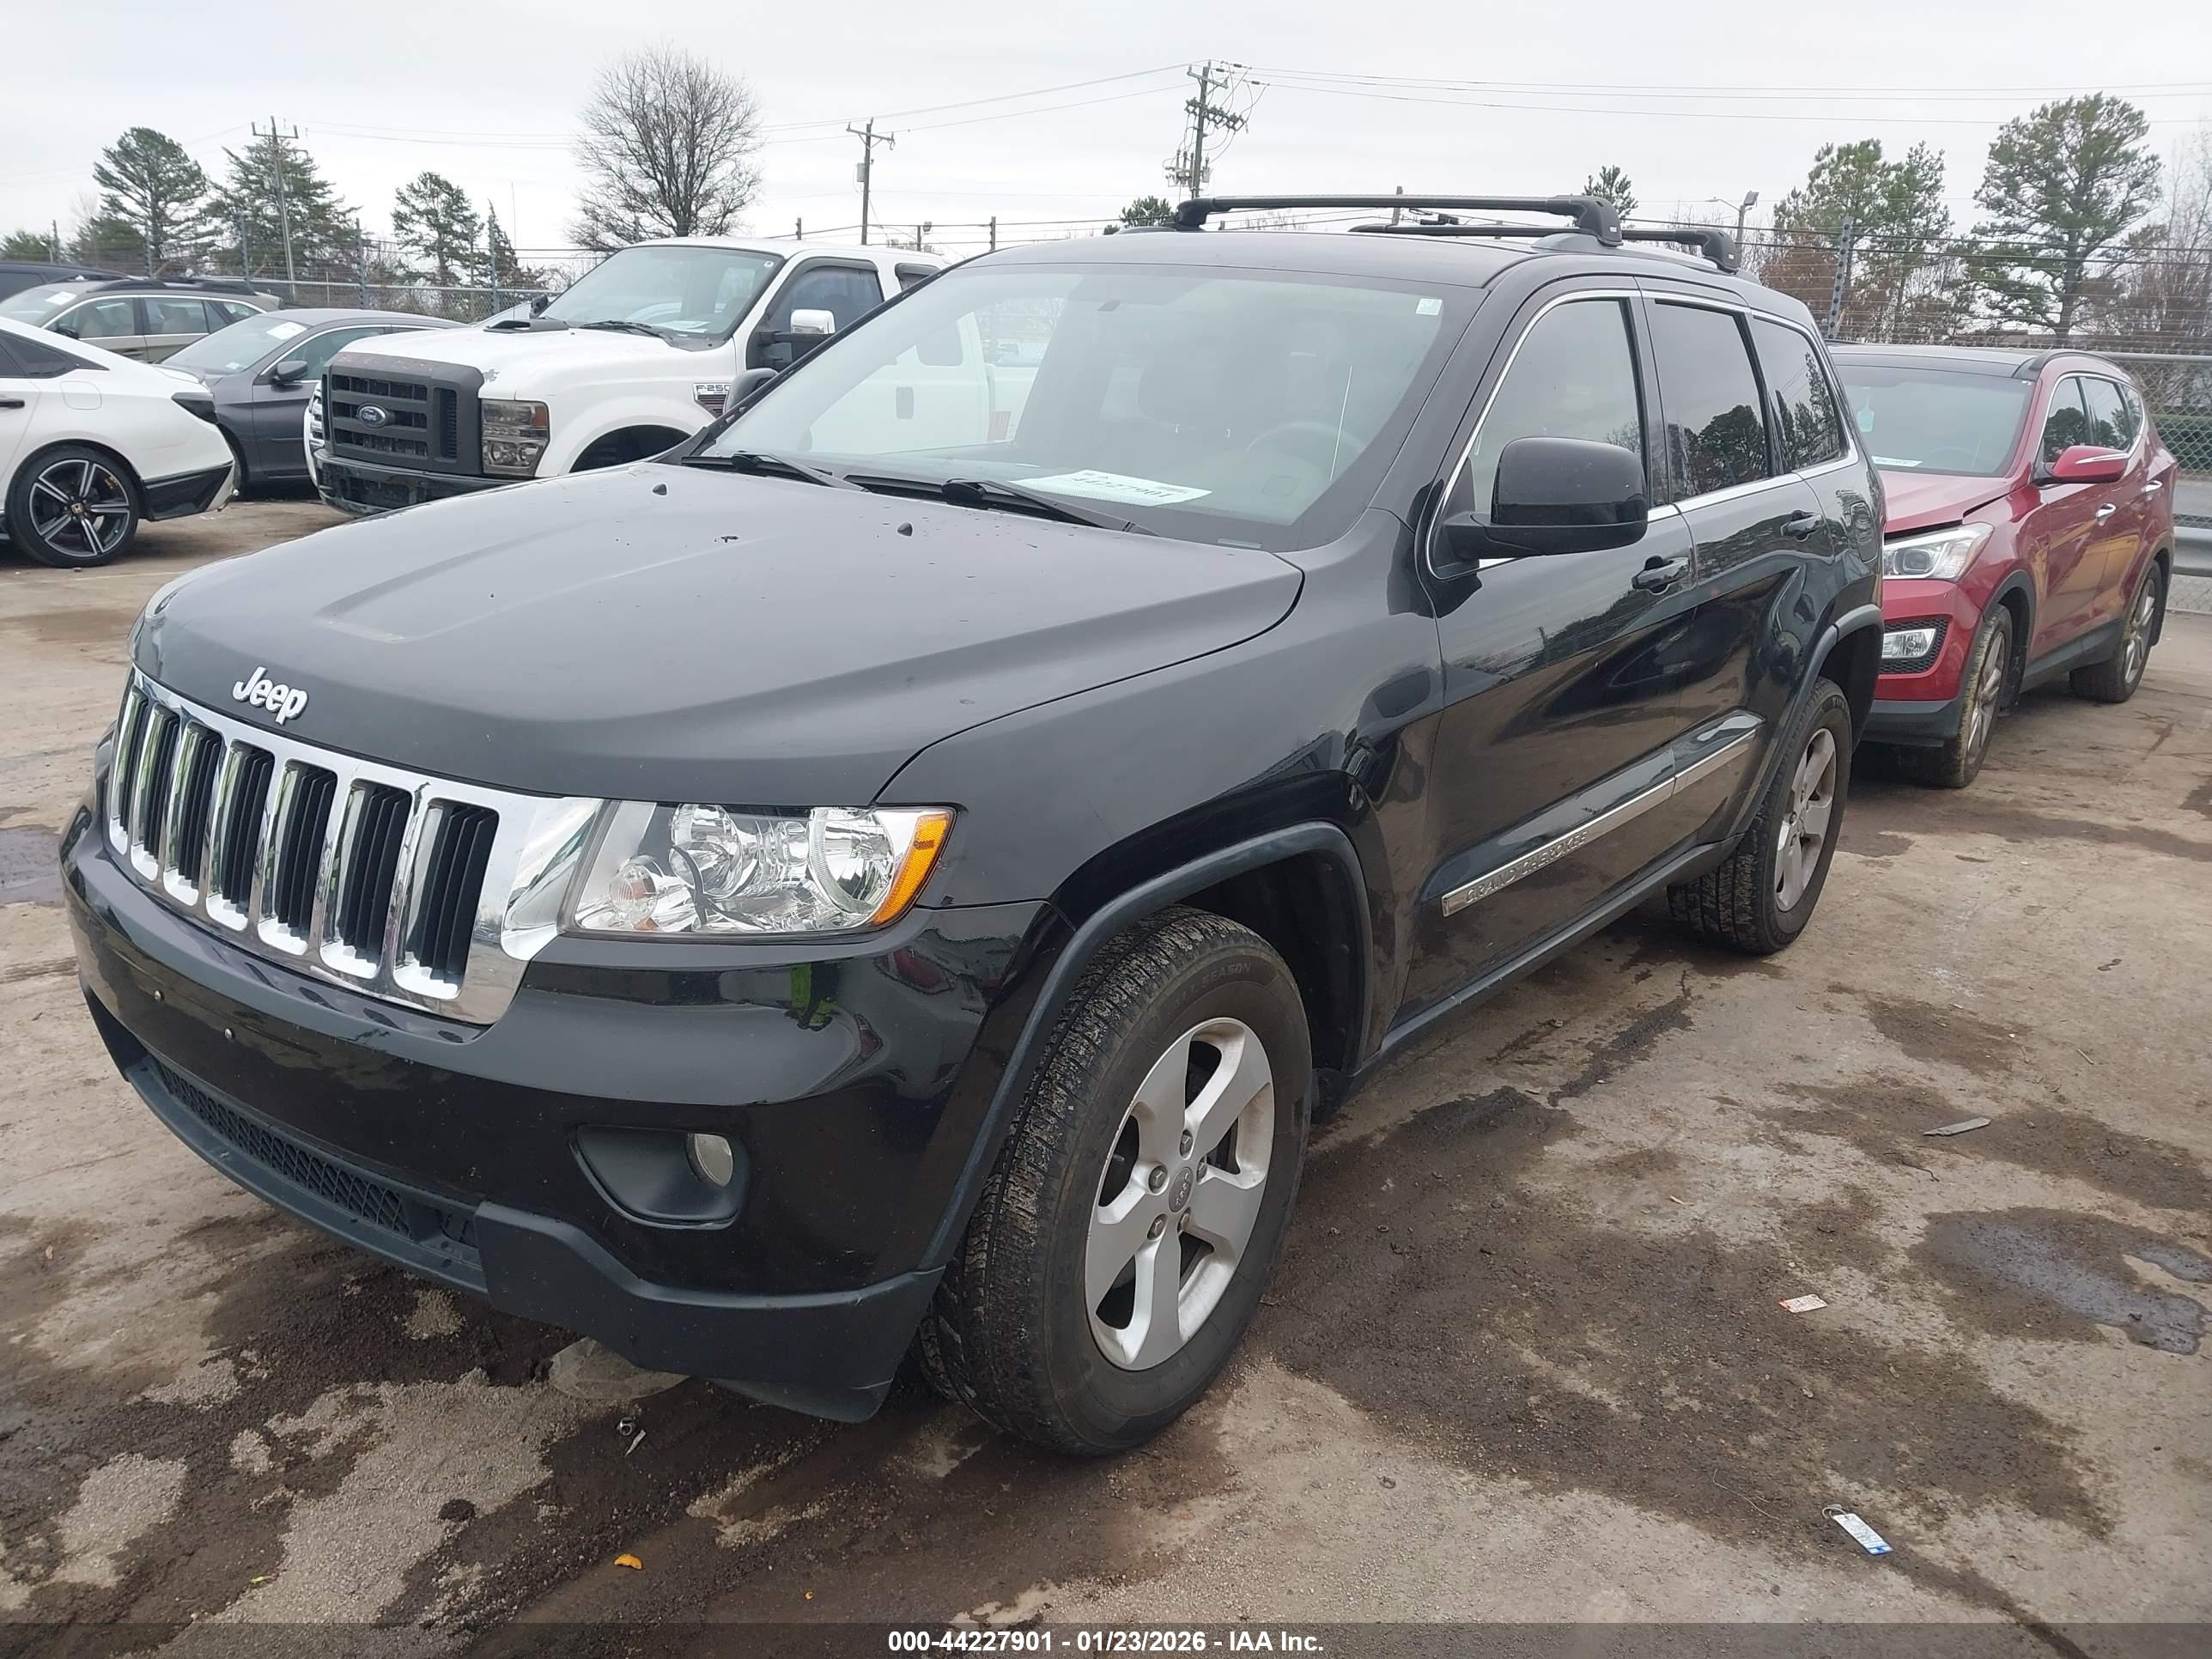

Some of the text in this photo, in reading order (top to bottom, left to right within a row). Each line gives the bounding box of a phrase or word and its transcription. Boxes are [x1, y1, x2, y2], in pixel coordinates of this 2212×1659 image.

[232, 665, 309, 726] Jeep
[1464, 830, 1588, 903] GRAND CHEROKEE
[1202, 963, 1251, 988] SEASON
